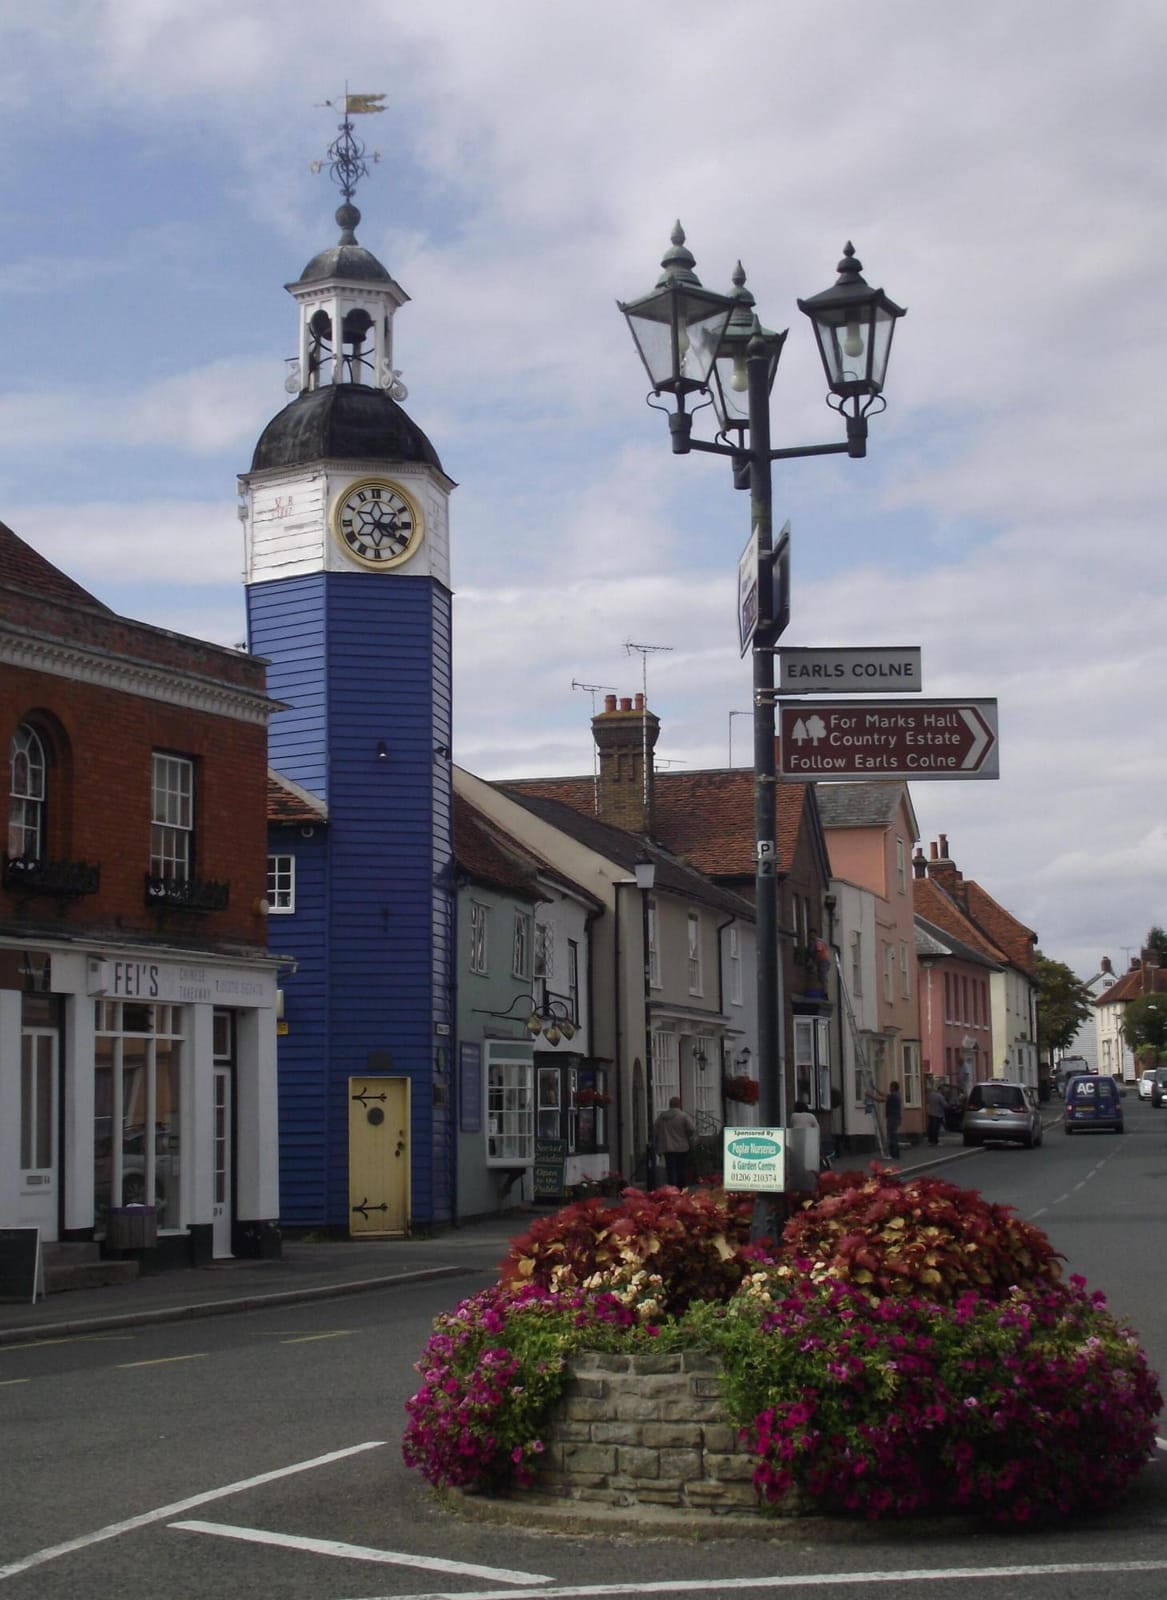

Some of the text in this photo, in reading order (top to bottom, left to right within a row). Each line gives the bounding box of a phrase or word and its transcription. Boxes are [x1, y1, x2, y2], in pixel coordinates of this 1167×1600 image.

[787, 662, 914, 678] EARLS COLNE
[830, 712, 958, 729] For Marks Hall
[829, 731, 961, 748] Country Estate
[790, 752, 957, 769] Follow Earls Colne
[760, 843, 770, 857] P
[762, 860, 772, 875] 2
[114, 961, 159, 997] FEI'S
[1076, 1082, 1096, 1095] AC
[731, 1173, 751, 1182] 01206
